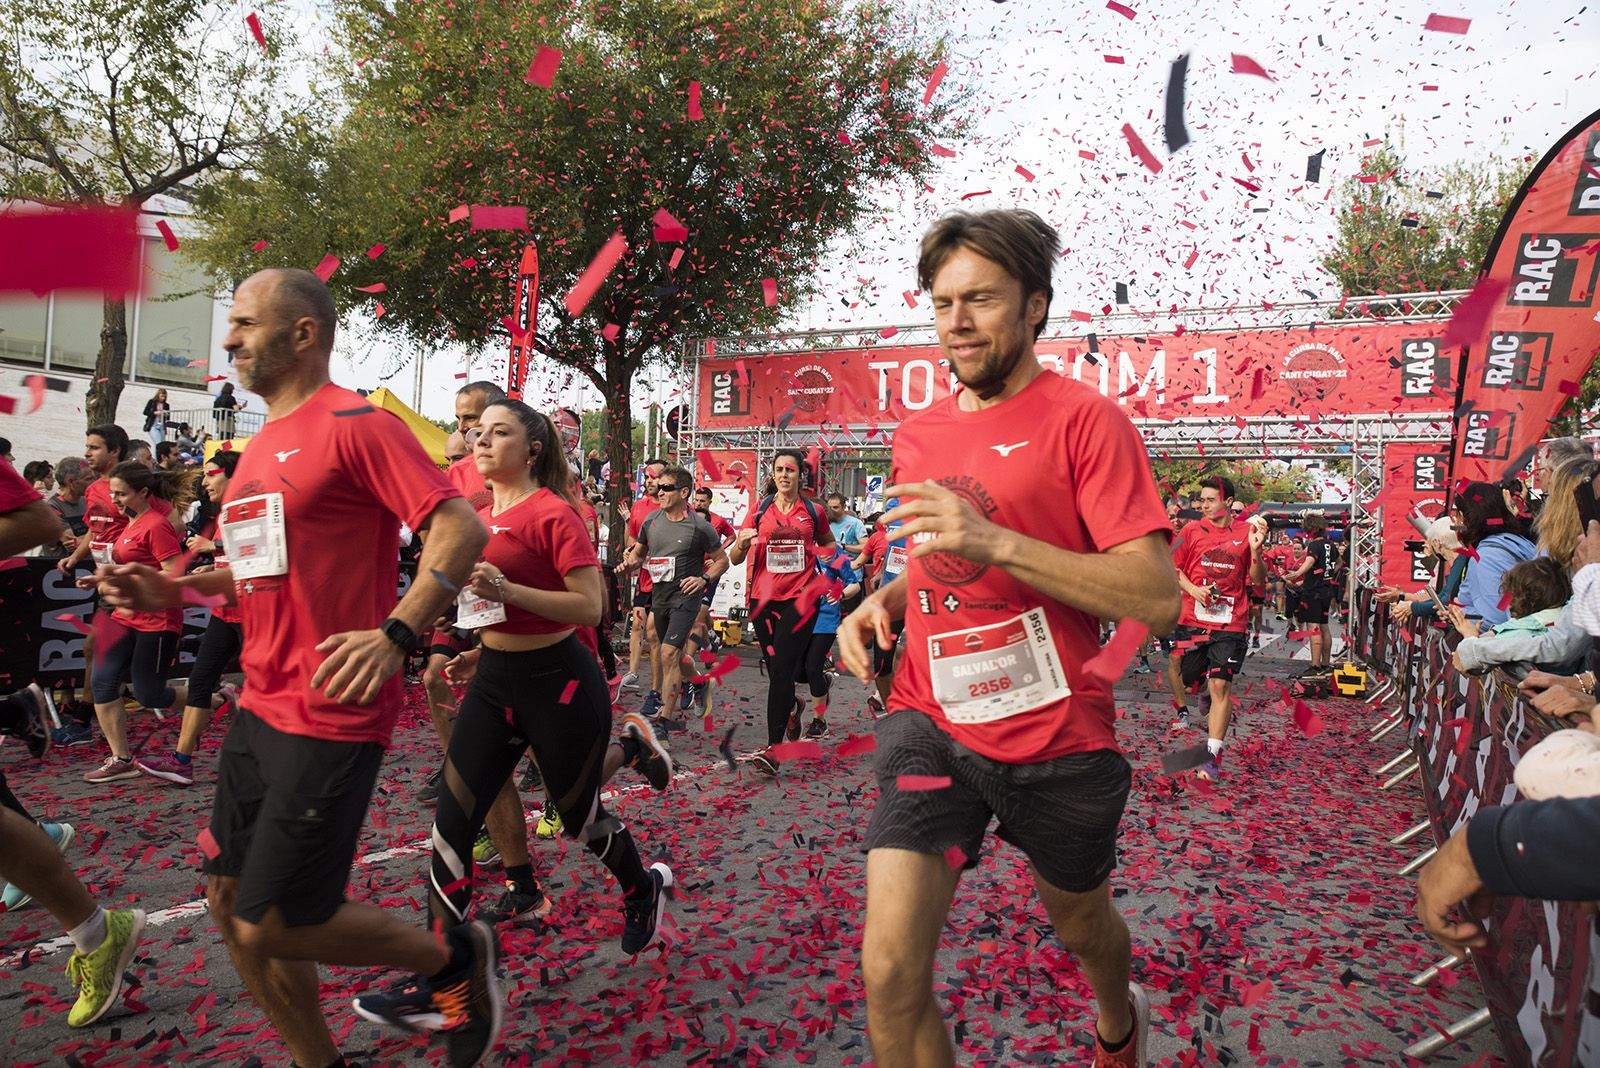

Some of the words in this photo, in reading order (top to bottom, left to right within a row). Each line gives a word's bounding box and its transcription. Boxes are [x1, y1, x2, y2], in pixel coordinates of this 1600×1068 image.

[1513, 238, 1562, 302] RAC
[1405, 341, 1435, 394] RAC
[1485, 335, 1519, 385] RAC
[713, 374, 732, 414] RAC
[1464, 413, 1490, 455] RAC
[39, 568, 96, 672] RAC
[1028, 612, 1047, 643] 2356
[952, 654, 1018, 678] SALVADOR
[968, 676, 1012, 698] 2356
